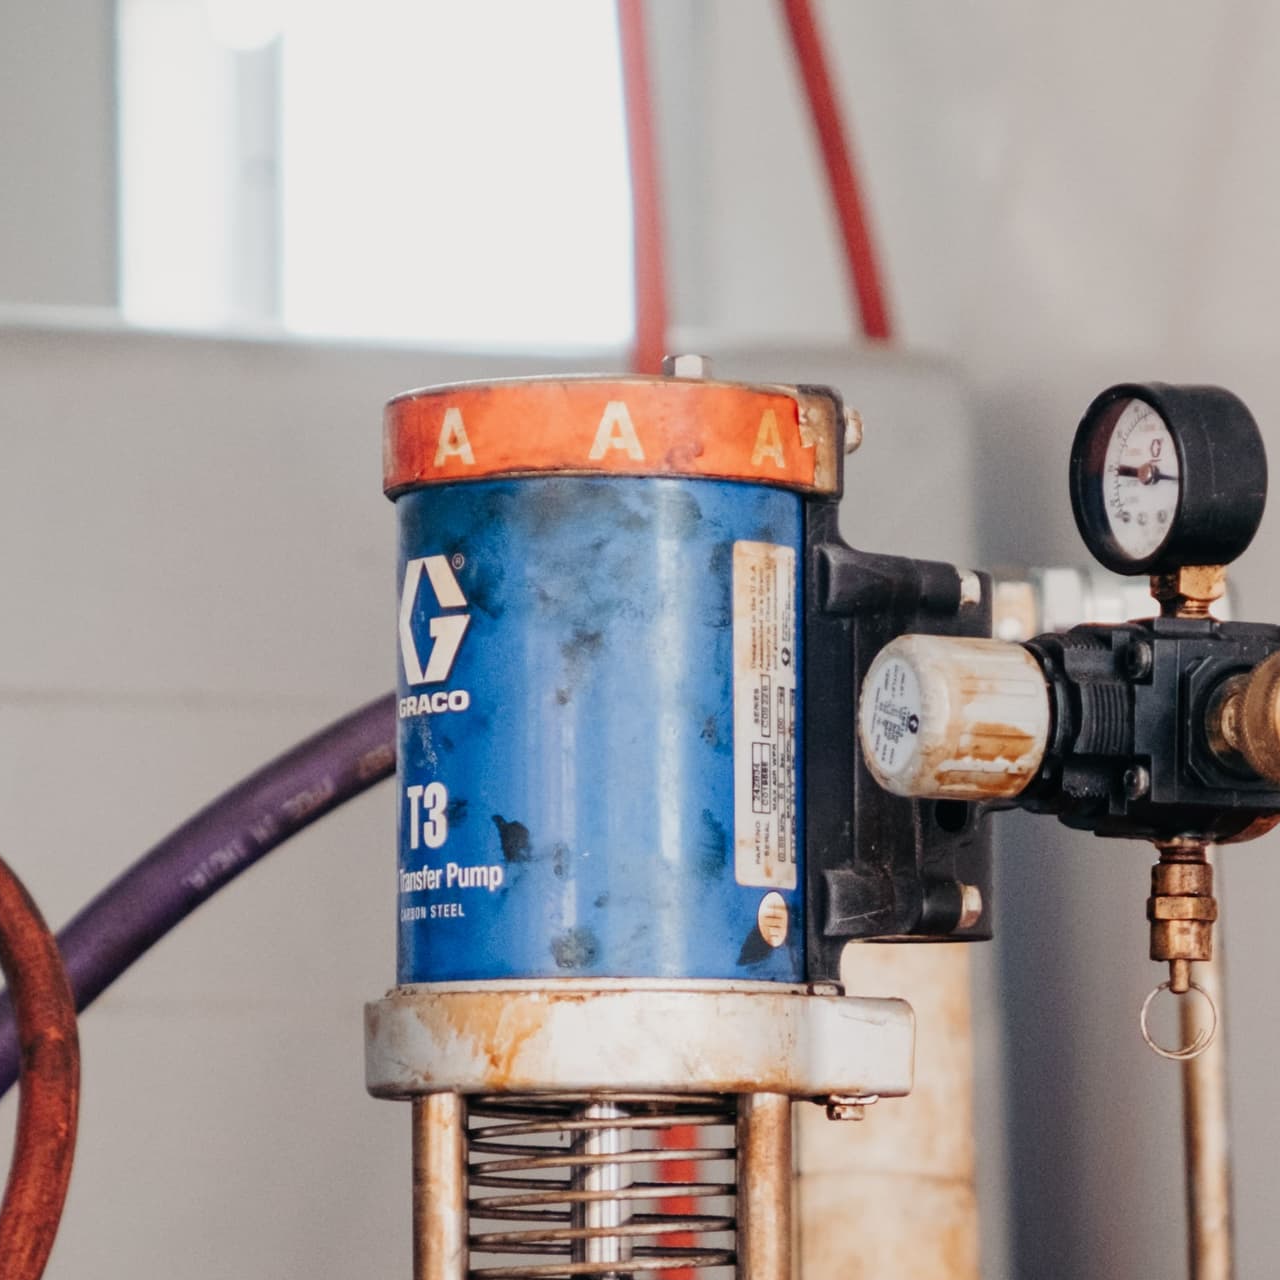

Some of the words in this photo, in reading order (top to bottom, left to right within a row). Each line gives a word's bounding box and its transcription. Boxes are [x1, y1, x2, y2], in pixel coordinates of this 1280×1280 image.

[433, 407, 475, 466] A
[588, 401, 645, 461] A
[750, 408, 785, 468] A
[399, 690, 470, 719] GRACO
[407, 782, 448, 850] T3
[446, 862, 504, 892] Pump
[430, 903, 466, 919] STEEL
